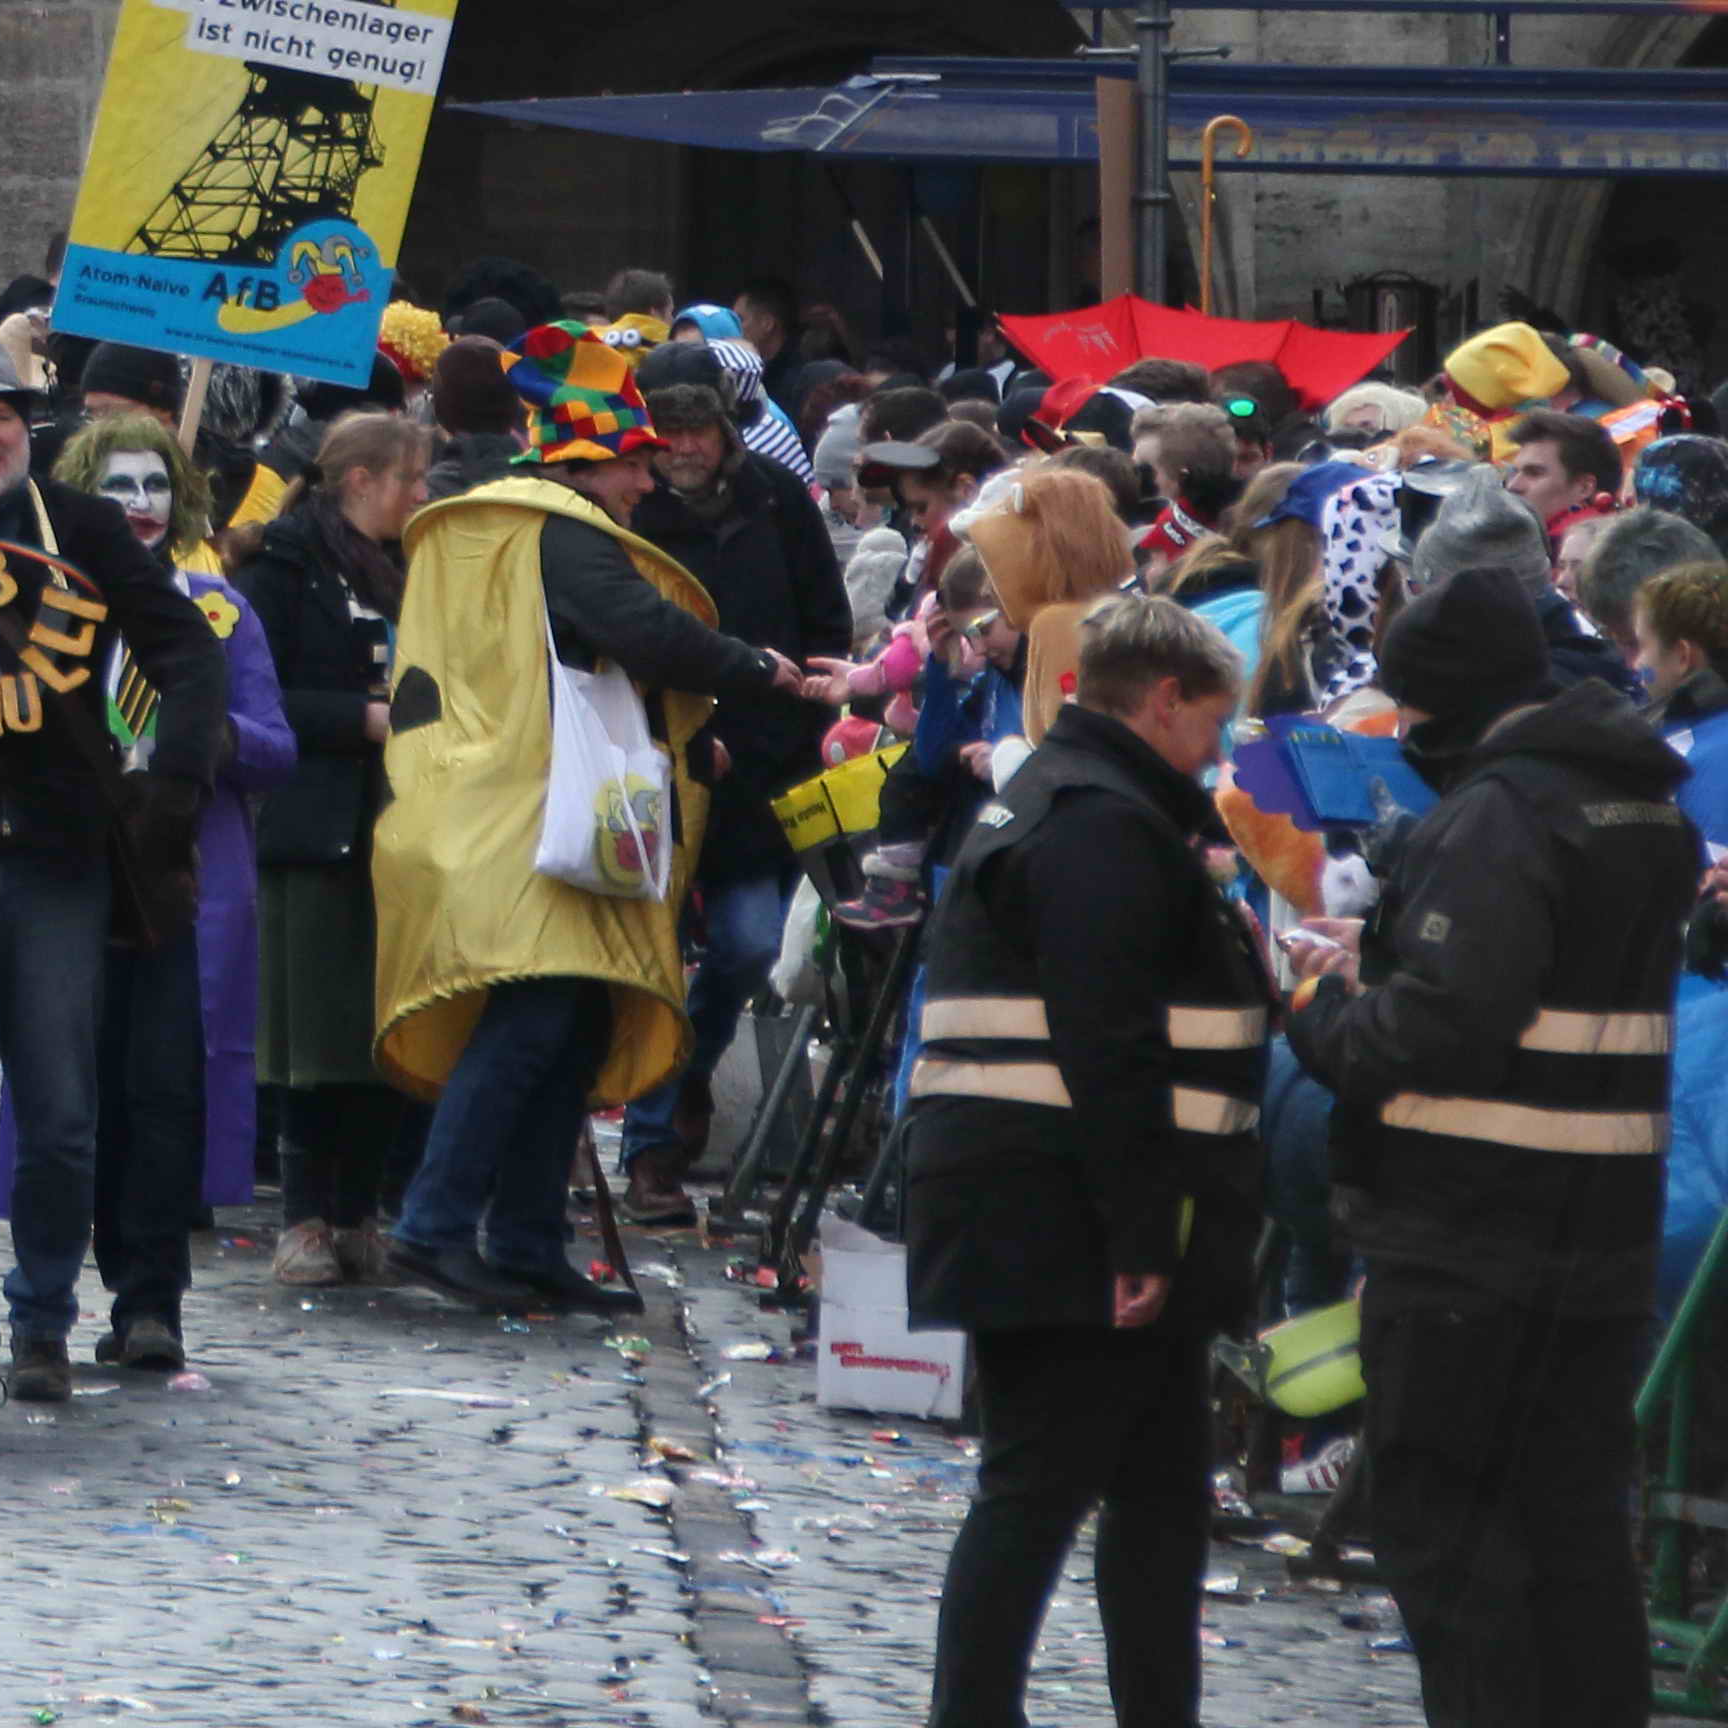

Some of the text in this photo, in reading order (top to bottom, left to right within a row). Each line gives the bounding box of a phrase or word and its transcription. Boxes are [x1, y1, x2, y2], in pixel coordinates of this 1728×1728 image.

[196, 18, 426, 83] ist nicht genug!
[201, 272, 281, 312] AfB
